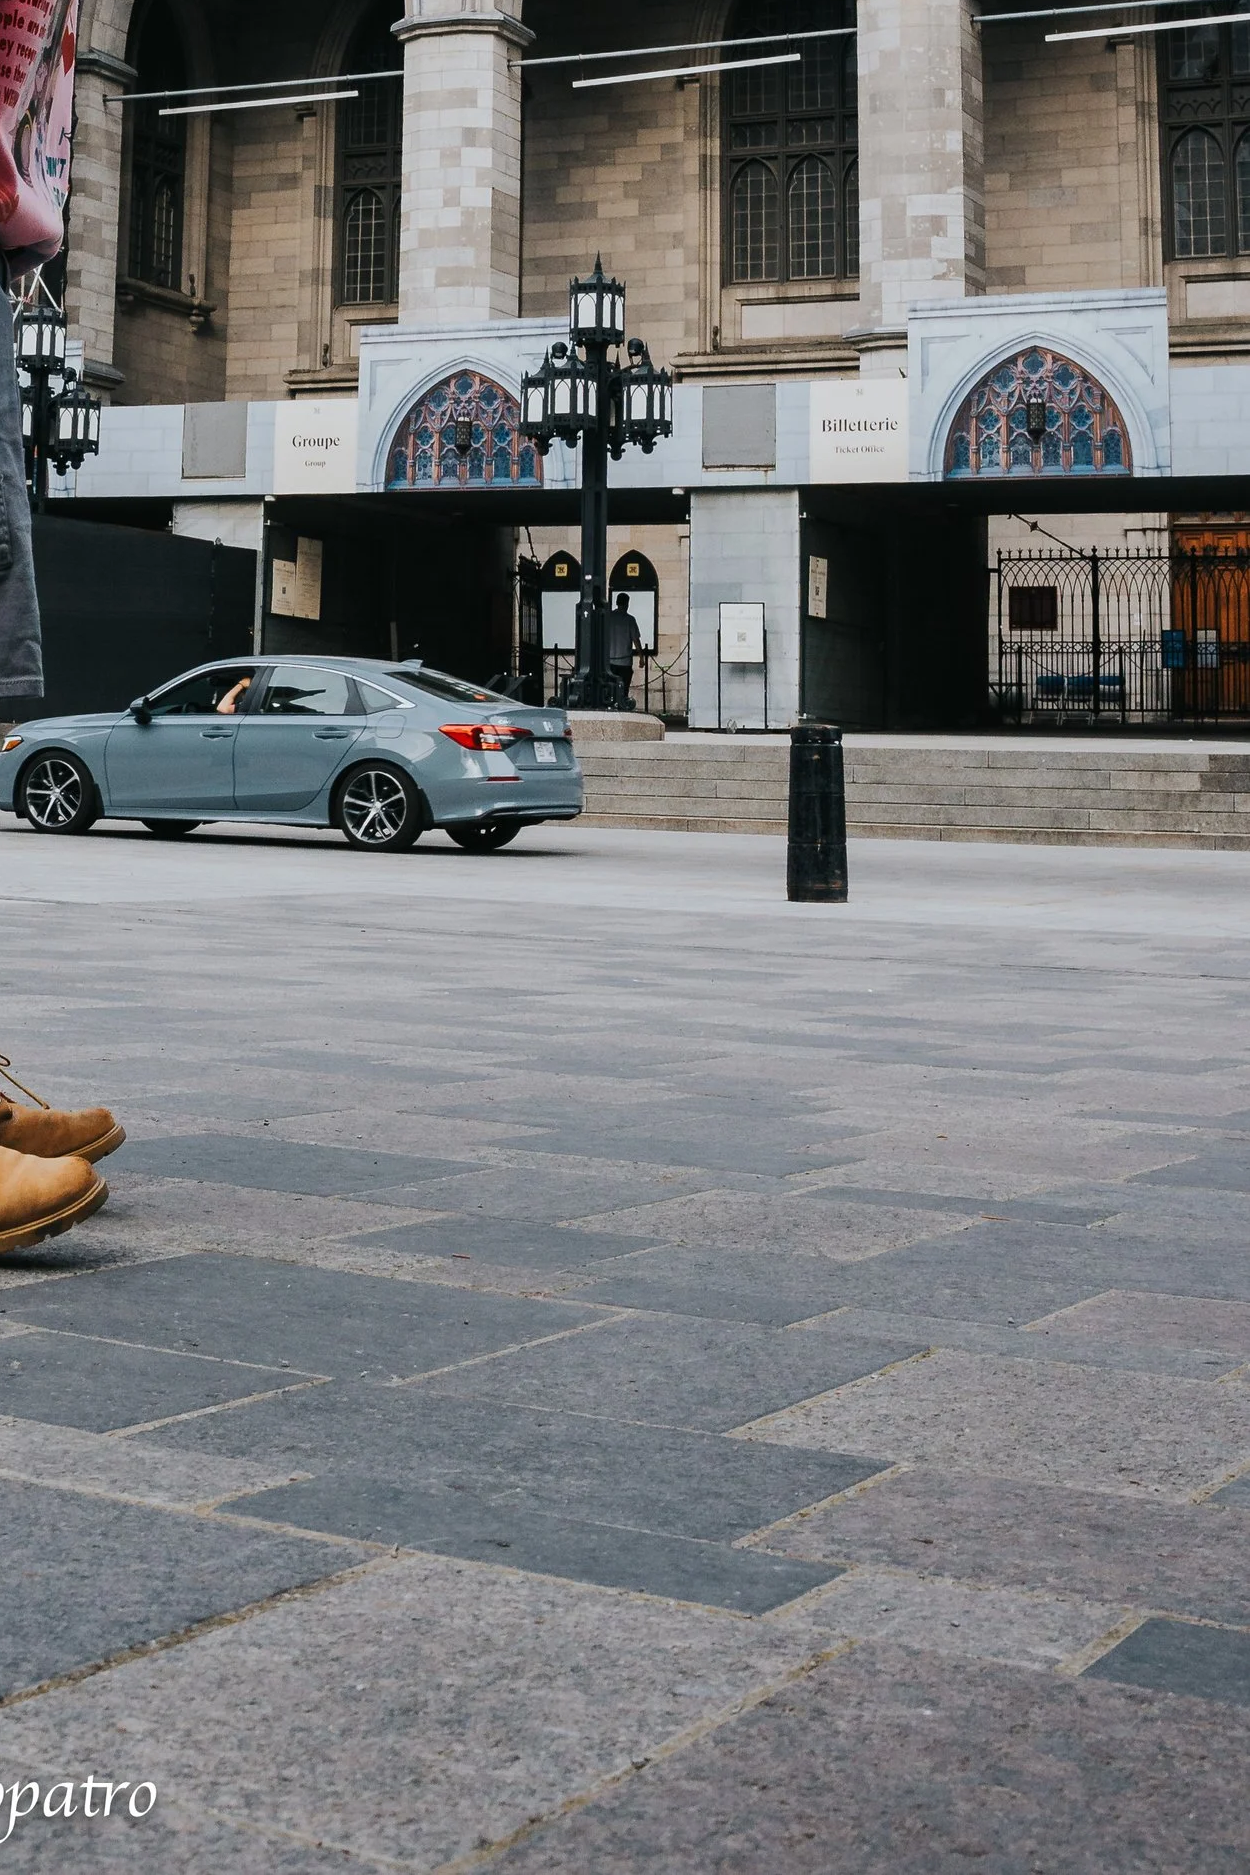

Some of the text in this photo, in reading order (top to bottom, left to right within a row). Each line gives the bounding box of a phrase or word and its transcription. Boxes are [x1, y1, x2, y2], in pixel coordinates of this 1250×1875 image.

[822, 417, 898, 432] Billetterie
[292, 434, 340, 449] Groupe
[835, 444, 885, 454] Ticket Office
[304, 460, 326, 468] Group
